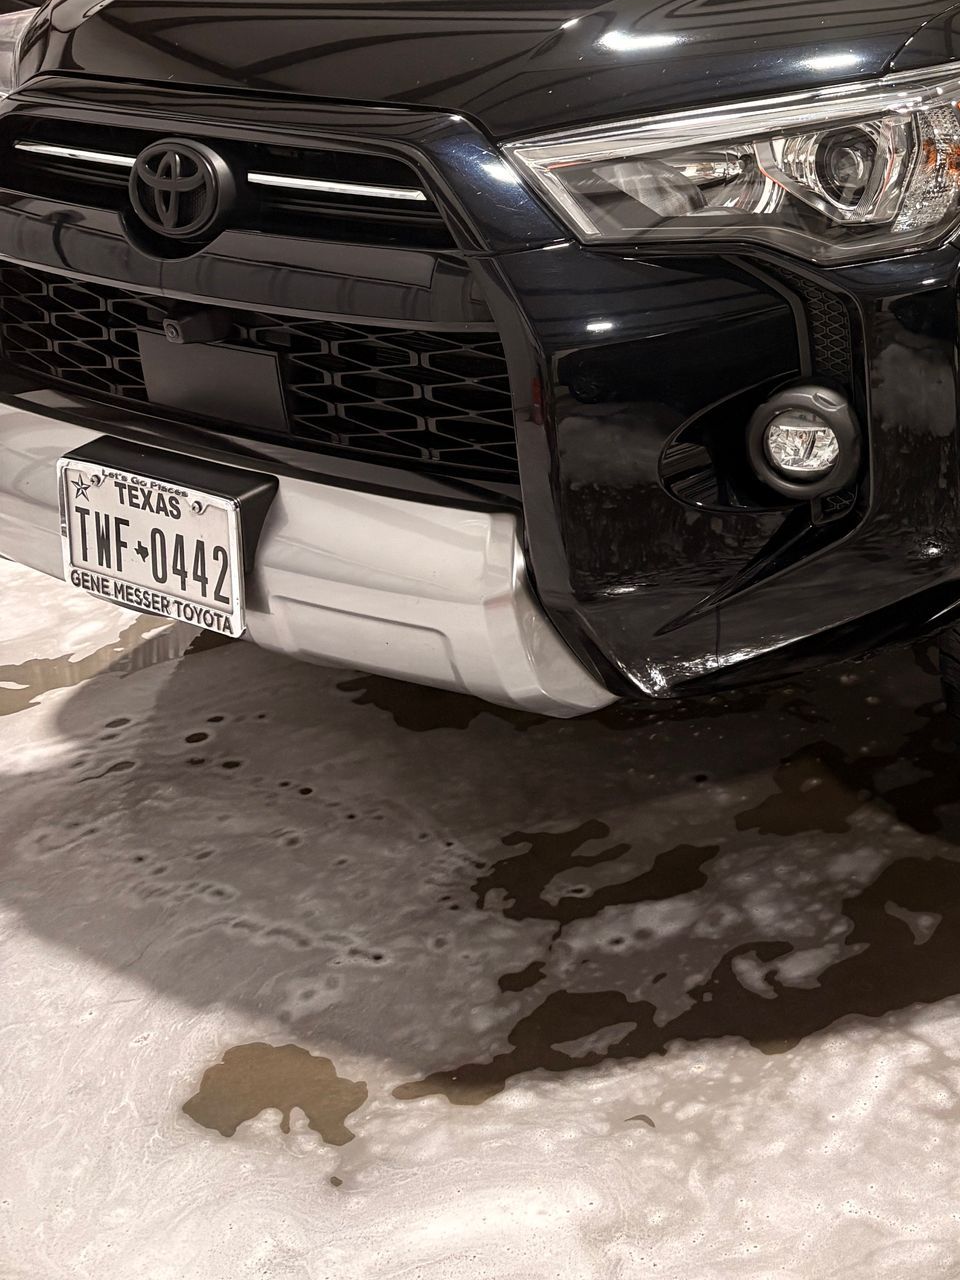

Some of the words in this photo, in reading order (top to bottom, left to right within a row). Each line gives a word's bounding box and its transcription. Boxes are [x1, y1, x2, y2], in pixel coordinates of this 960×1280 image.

[101, 468, 128, 482] Let's
[130, 476, 148, 487] Go
[150, 481, 189, 498] Places
[114, 481, 181, 520] TEXAS
[70, 569, 110, 598] GENE
[113, 581, 170, 614] MESSER
[173, 599, 234, 635] TOYOTA
